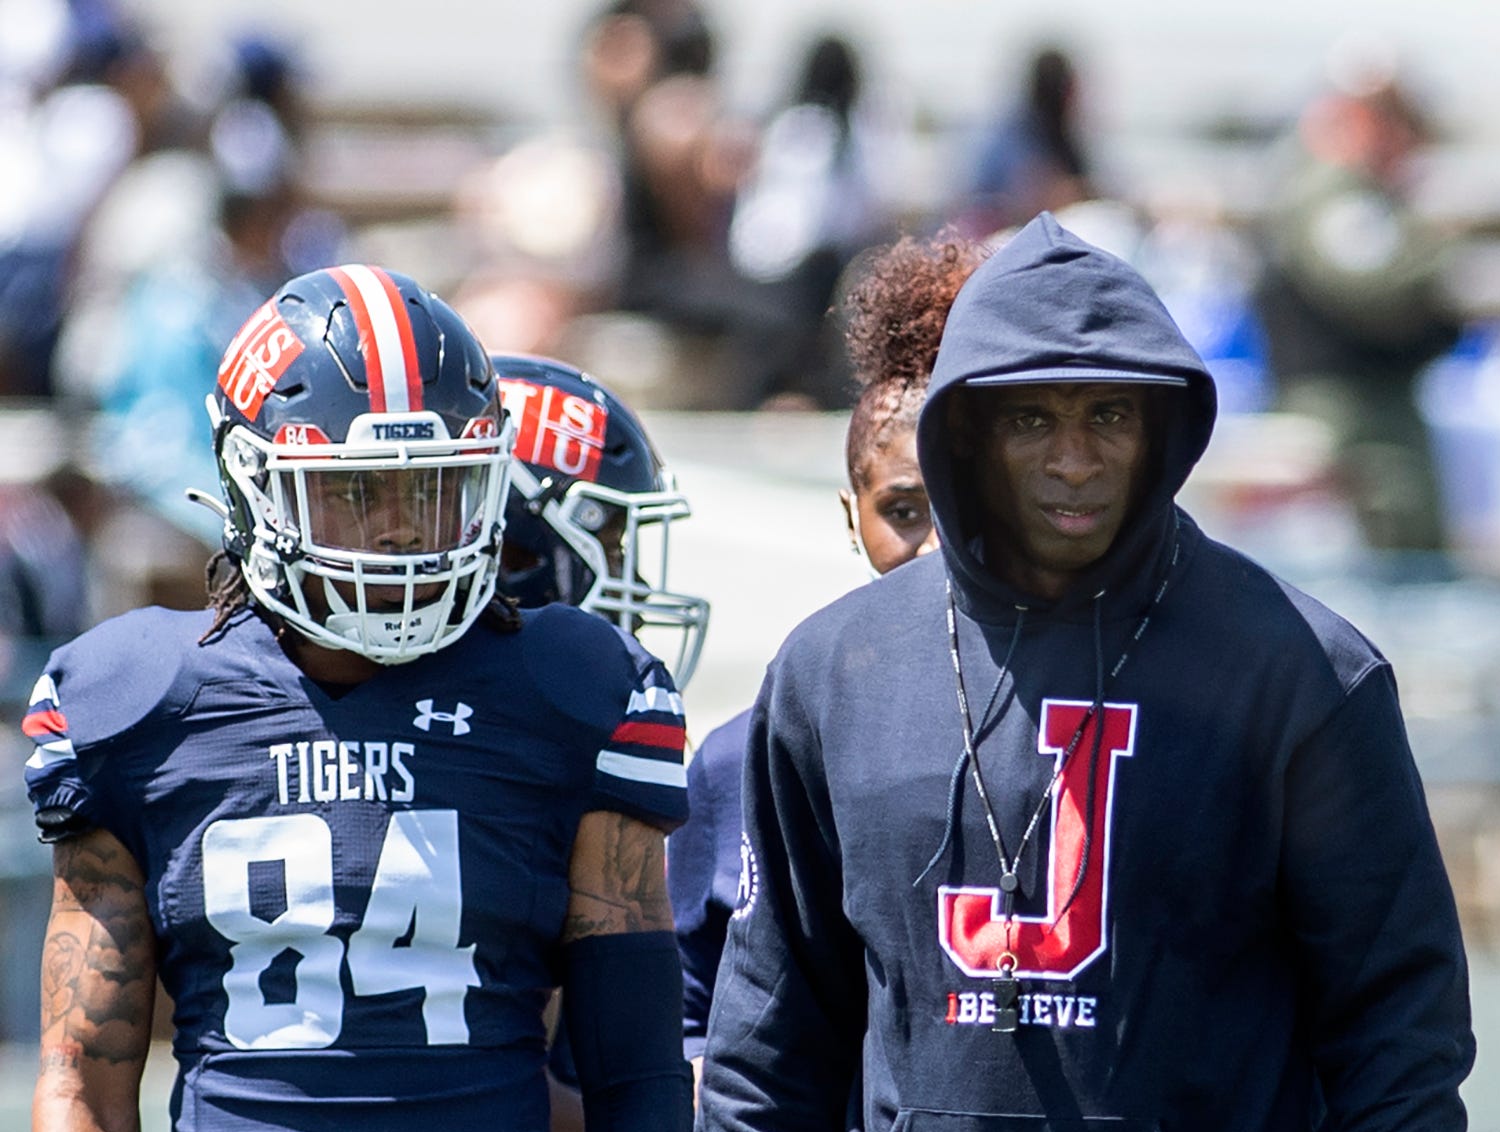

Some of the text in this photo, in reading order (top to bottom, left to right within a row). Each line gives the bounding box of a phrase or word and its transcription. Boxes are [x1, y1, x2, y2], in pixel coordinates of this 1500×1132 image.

[285, 425, 309, 446] 84
[372, 422, 434, 440] TIGERS
[384, 616, 422, 631] Ridell
[269, 740, 415, 805] TIGERS
[937, 697, 1138, 982] J
[202, 808, 483, 1050] 84
[944, 991, 1097, 1028] IBEIEVE
